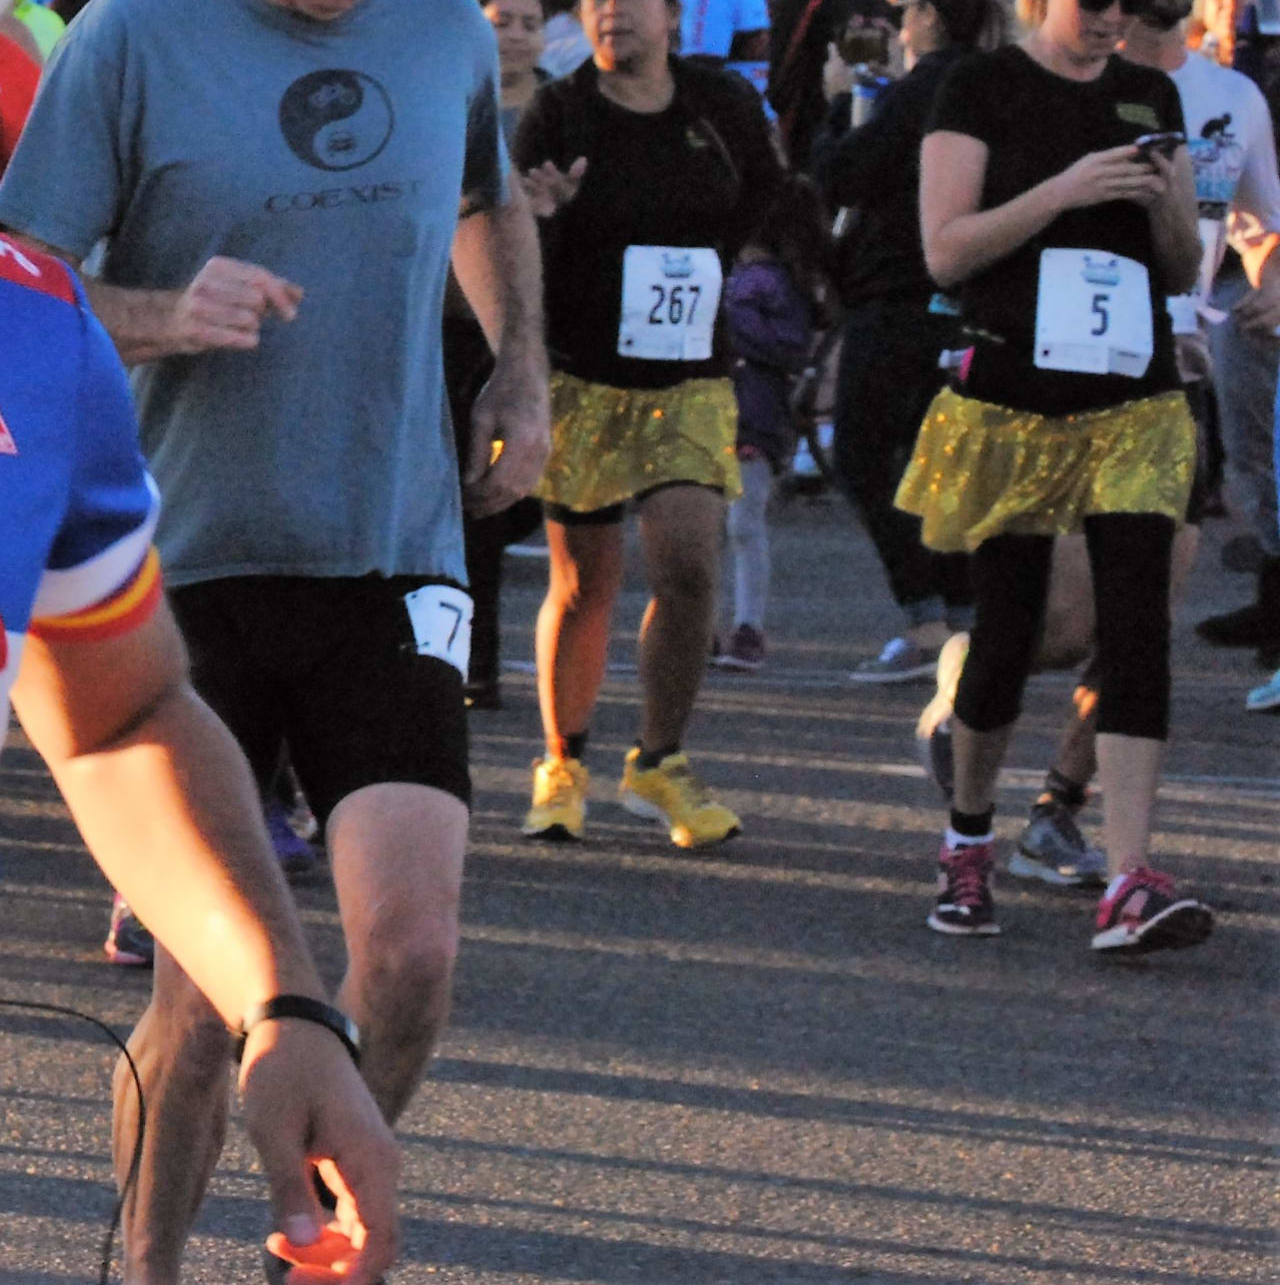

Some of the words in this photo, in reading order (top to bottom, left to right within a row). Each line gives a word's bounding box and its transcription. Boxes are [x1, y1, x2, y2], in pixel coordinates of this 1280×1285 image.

[264, 178, 426, 213] COEXIST
[649, 284, 701, 325] 267
[1091, 293, 1109, 336] 5
[439, 601, 463, 653] 7
